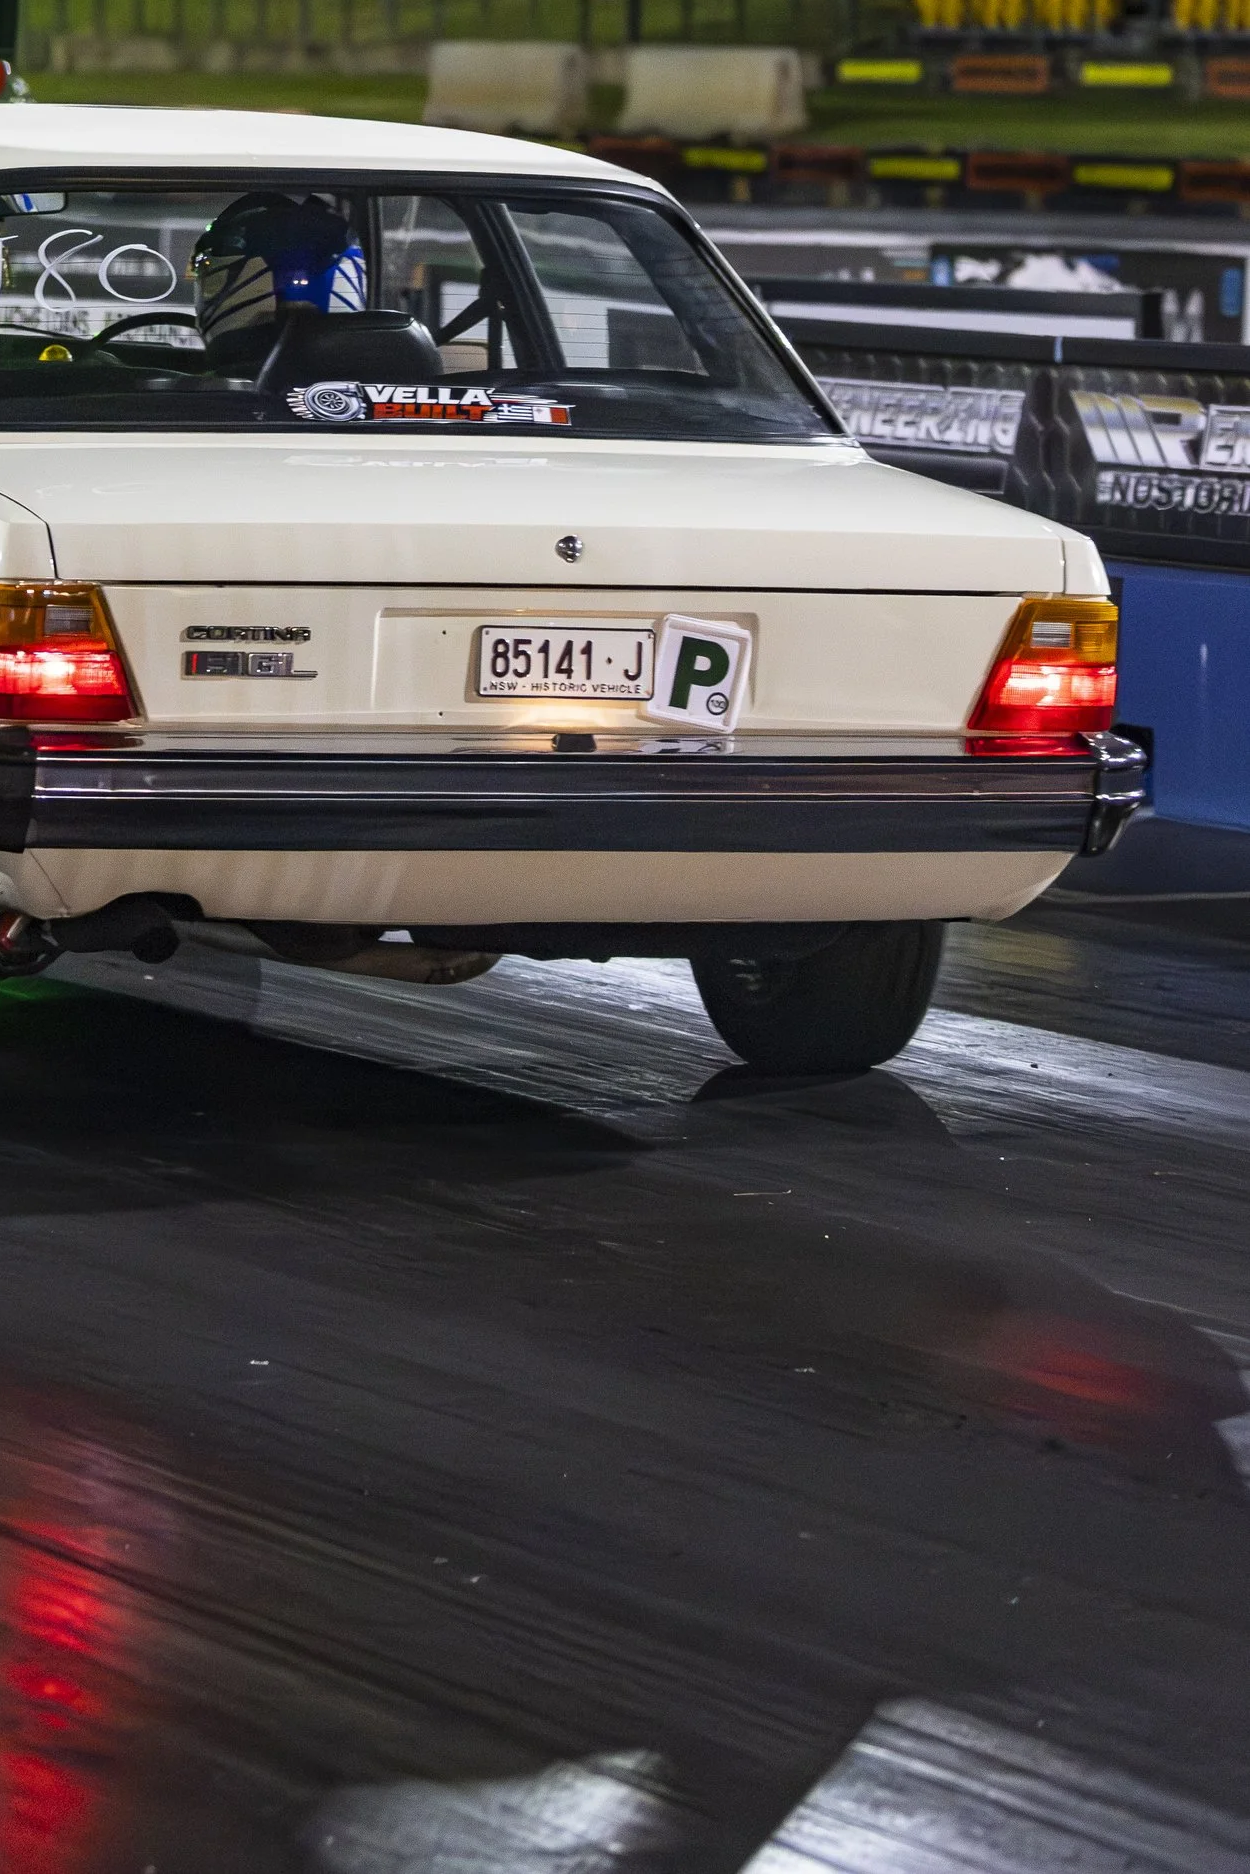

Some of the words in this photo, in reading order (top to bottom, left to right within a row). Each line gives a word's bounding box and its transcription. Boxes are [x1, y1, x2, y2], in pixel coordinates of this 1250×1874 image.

[362, 385, 493, 405] VELLA
[373, 403, 492, 421] BUILT
[491, 638, 592, 680] 85141
[623, 641, 643, 682] J
[668, 636, 730, 709] P
[489, 681, 518, 692] NSW
[531, 682, 587, 693] HISTORIC
[592, 684, 641, 695] VEHICLE
